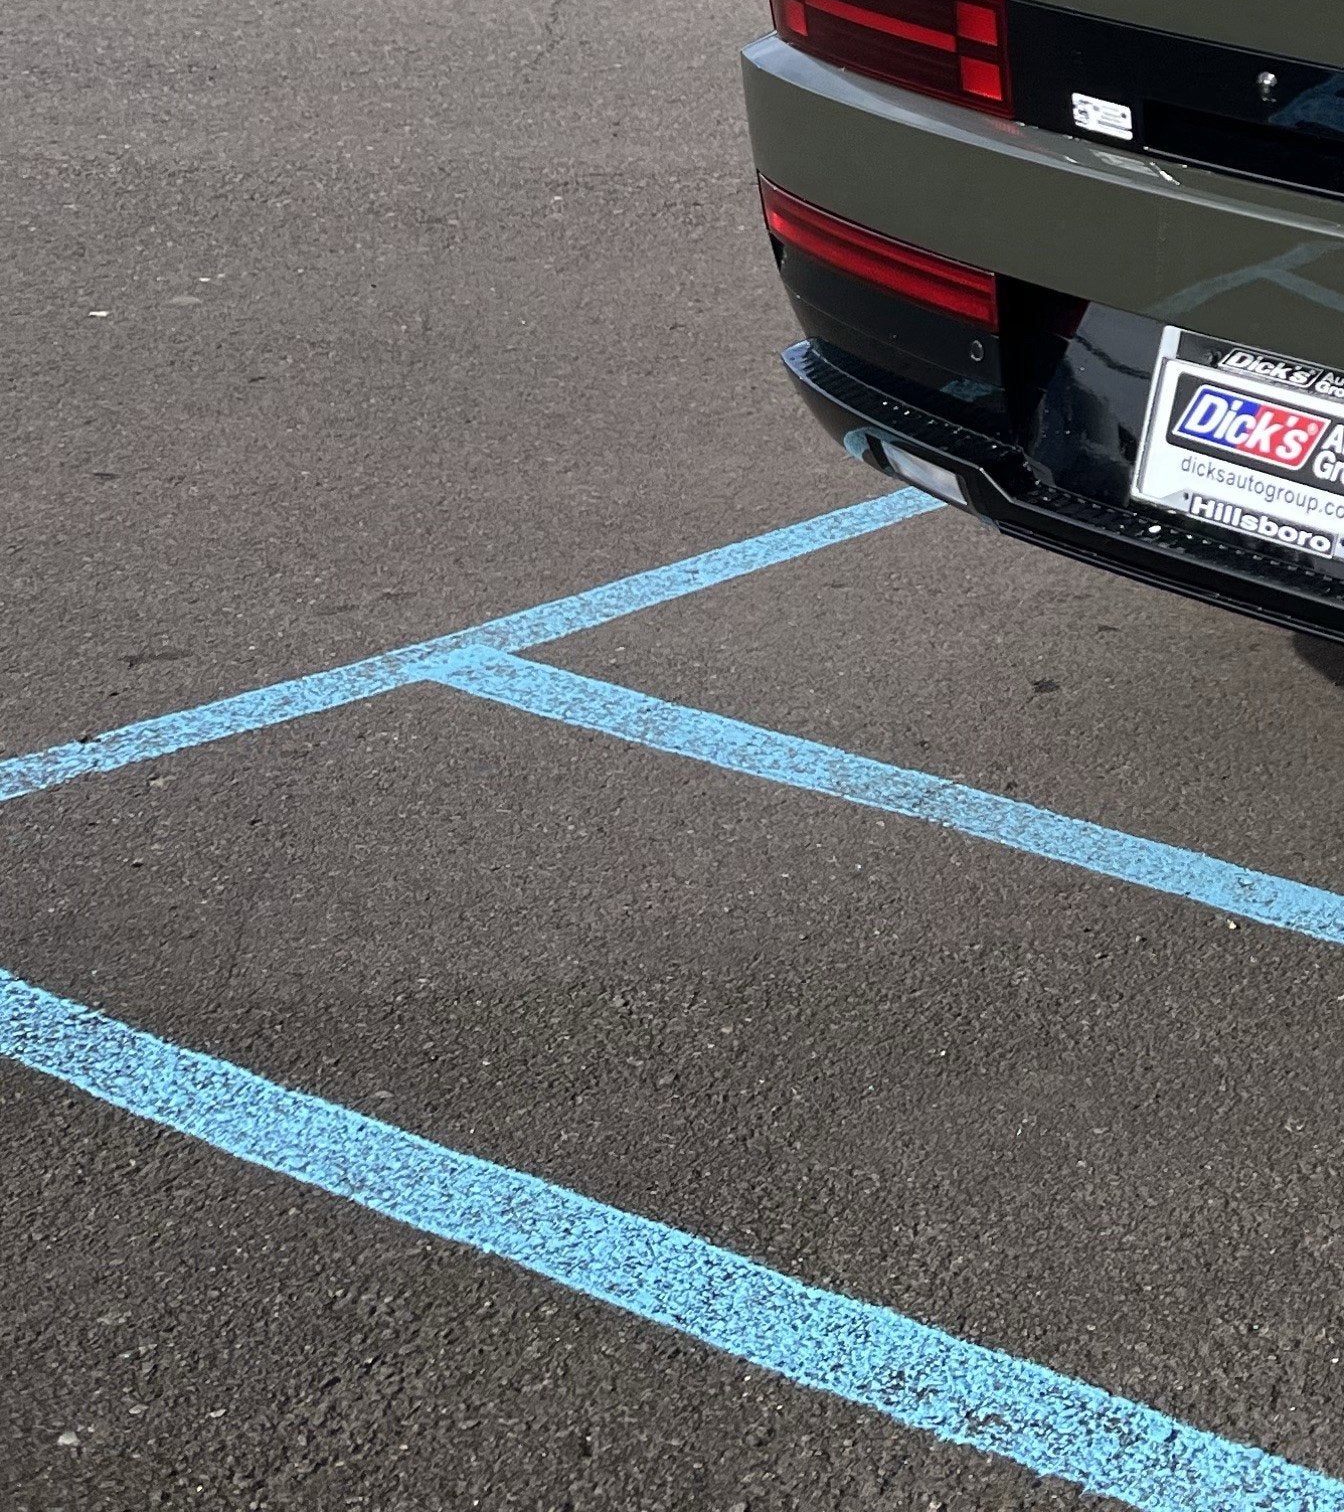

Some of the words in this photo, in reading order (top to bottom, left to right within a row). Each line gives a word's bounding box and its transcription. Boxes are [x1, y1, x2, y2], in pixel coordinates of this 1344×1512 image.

[1227, 351, 1316, 384] Dick's
[1184, 393, 1318, 462] Dick's
[1189, 495, 1333, 554] Hillsboro
